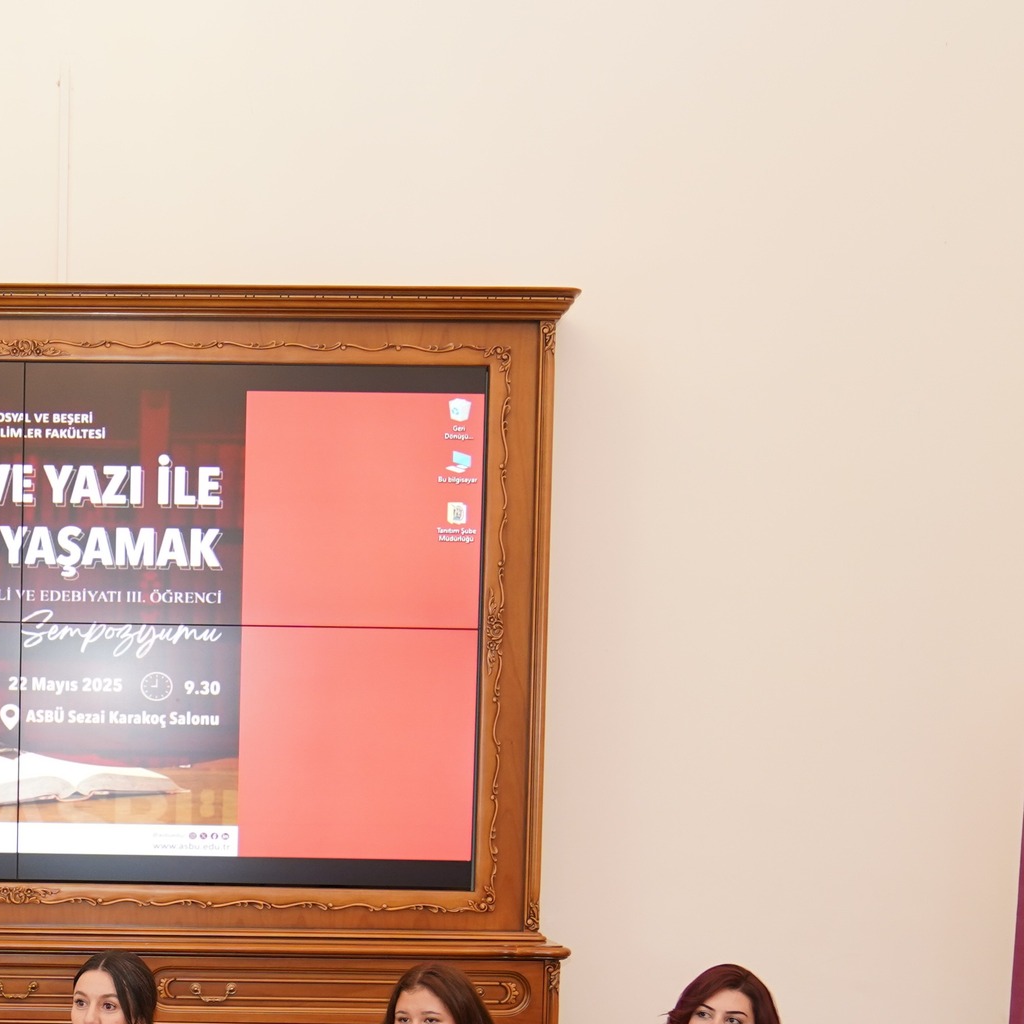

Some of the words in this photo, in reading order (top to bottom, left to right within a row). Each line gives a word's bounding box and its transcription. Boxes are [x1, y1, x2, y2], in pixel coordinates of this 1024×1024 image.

[34, 412, 49, 424] VE
[52, 411, 93, 426] BEŞERİ
[45, 426, 106, 439] FAKÜLTESİ
[43, 464, 144, 508] YAZI
[158, 453, 223, 509] İLE
[0, 525, 223, 580] YAŞAMAK
[16, 589, 36, 601] VE
[40, 588, 121, 602] EDEBİYATI
[127, 591, 146, 603] III.
[150, 589, 222, 604] ÖĞRENCİ
[21, 609, 223, 658] Sempozyumu
[8, 676, 28, 691] 22
[32, 676, 78, 695] Mayıs
[82, 677, 123, 692] 2025
[184, 680, 221, 695] 9.30
[26, 706, 64, 723] ASBÜ
[68, 708, 106, 724] Sezai
[109, 710, 166, 728] Karakoç
[169, 711, 220, 726] Salonu
